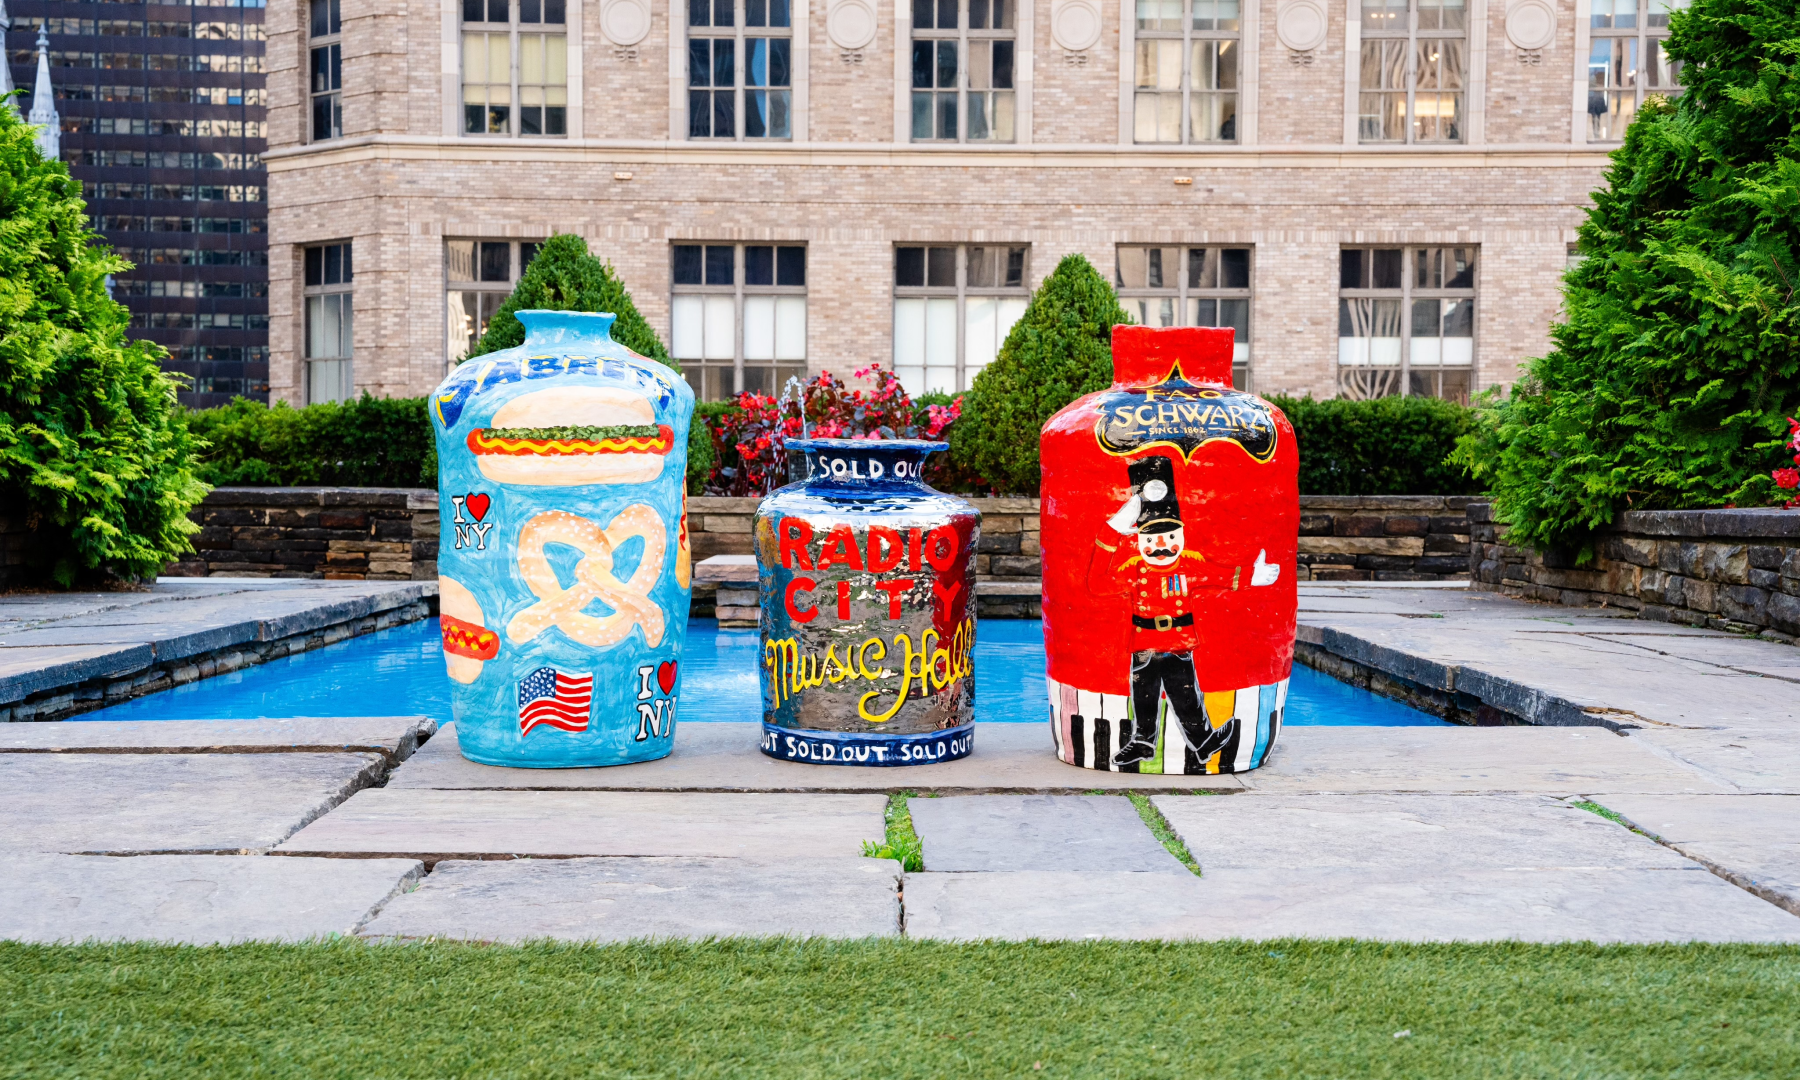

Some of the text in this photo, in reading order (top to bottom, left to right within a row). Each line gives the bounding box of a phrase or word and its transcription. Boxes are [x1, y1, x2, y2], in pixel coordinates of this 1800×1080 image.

[1112, 403, 1266, 433] SCHWARZ
[1148, 426, 1206, 435] SINCE 1862
[819, 455, 884, 479] SOLD
[452, 496, 465, 523] I
[455, 523, 493, 550] NY
[779, 516, 959, 573] RADIO
[784, 577, 961, 624] CITY
[637, 665, 654, 700] I
[765, 617, 972, 723] Music Hall
[635, 696, 677, 742] NY
[786, 736, 836, 761] SOLD
[841, 745, 888, 762] OUT
[901, 741, 947, 761] SOLD
[950, 734, 972, 756] OUT
